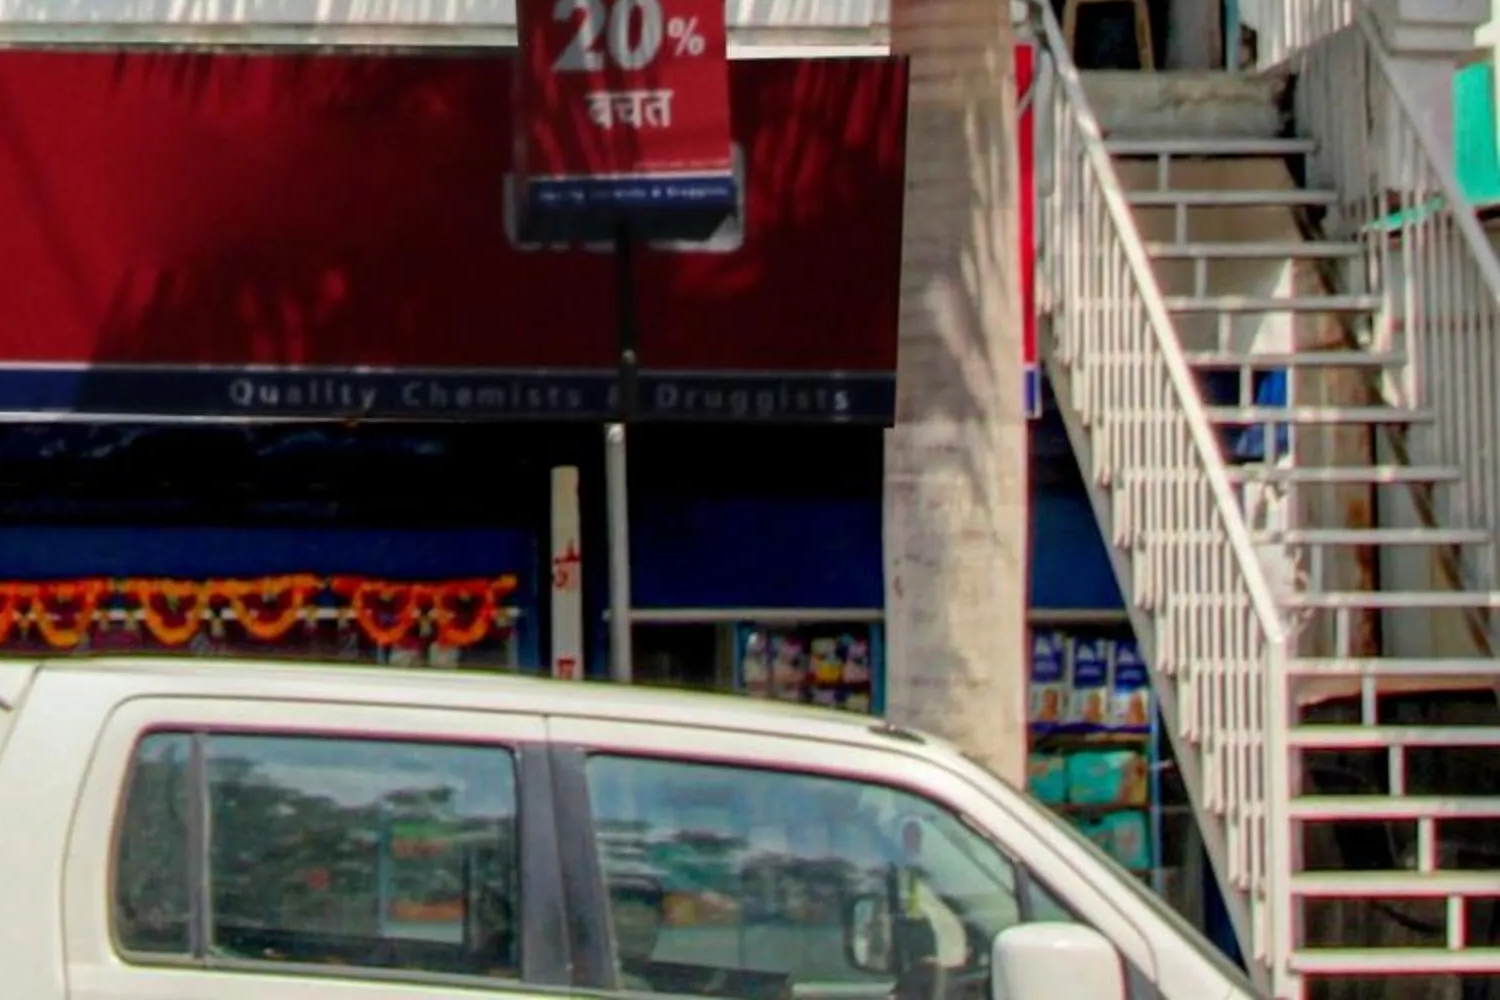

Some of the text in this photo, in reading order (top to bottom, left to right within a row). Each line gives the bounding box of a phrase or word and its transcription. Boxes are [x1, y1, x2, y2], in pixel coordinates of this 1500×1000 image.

[586, 88, 675, 131] बचत
[229, 378, 377, 412] Quality
[402, 380, 583, 411] Chemists
[655, 382, 850, 416] Druggists
